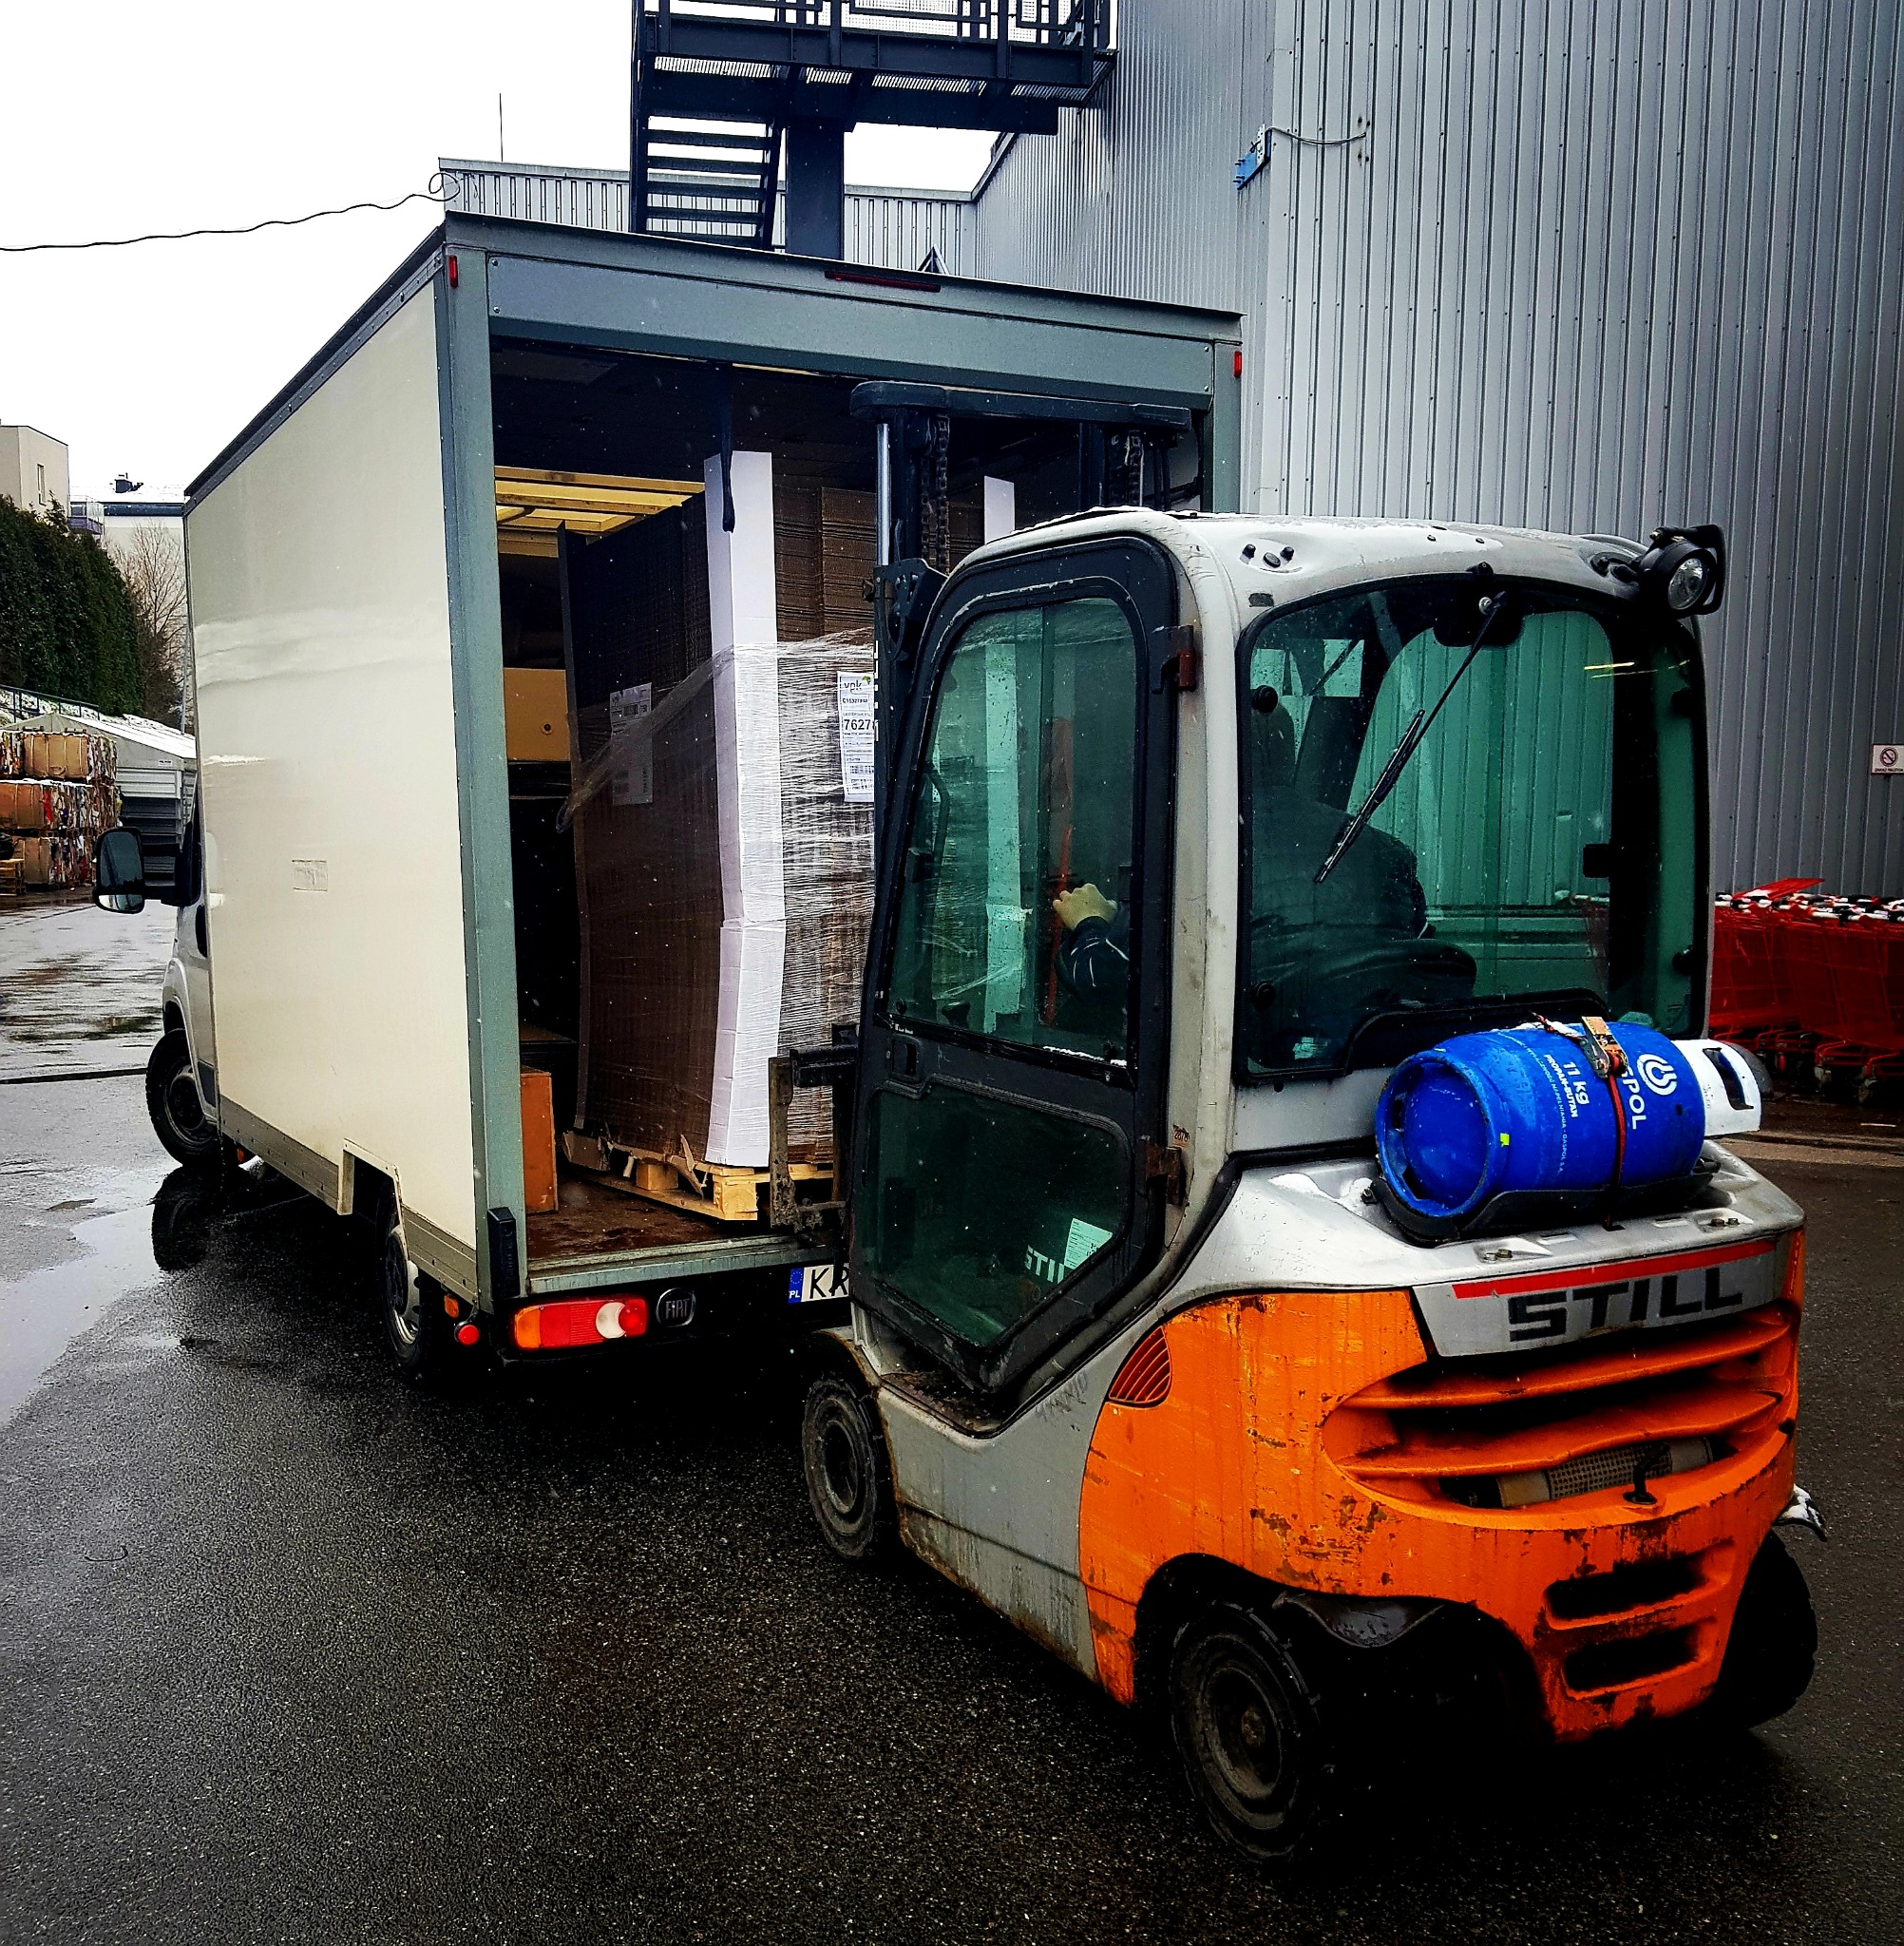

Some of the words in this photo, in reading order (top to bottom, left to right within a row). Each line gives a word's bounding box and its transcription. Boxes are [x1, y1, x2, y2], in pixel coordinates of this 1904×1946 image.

[844, 679, 862, 693] vpk
[844, 718, 874, 731] 7627
[1543, 1054, 1579, 1118] PROPAN-BUTAN
[1563, 1061, 1581, 1076] 11
[1573, 1081, 1590, 1105] kg
[789, 1290, 801, 1299] PL
[1507, 1268, 1744, 1343] STILL
[665, 1298, 691, 1320] FIAT
